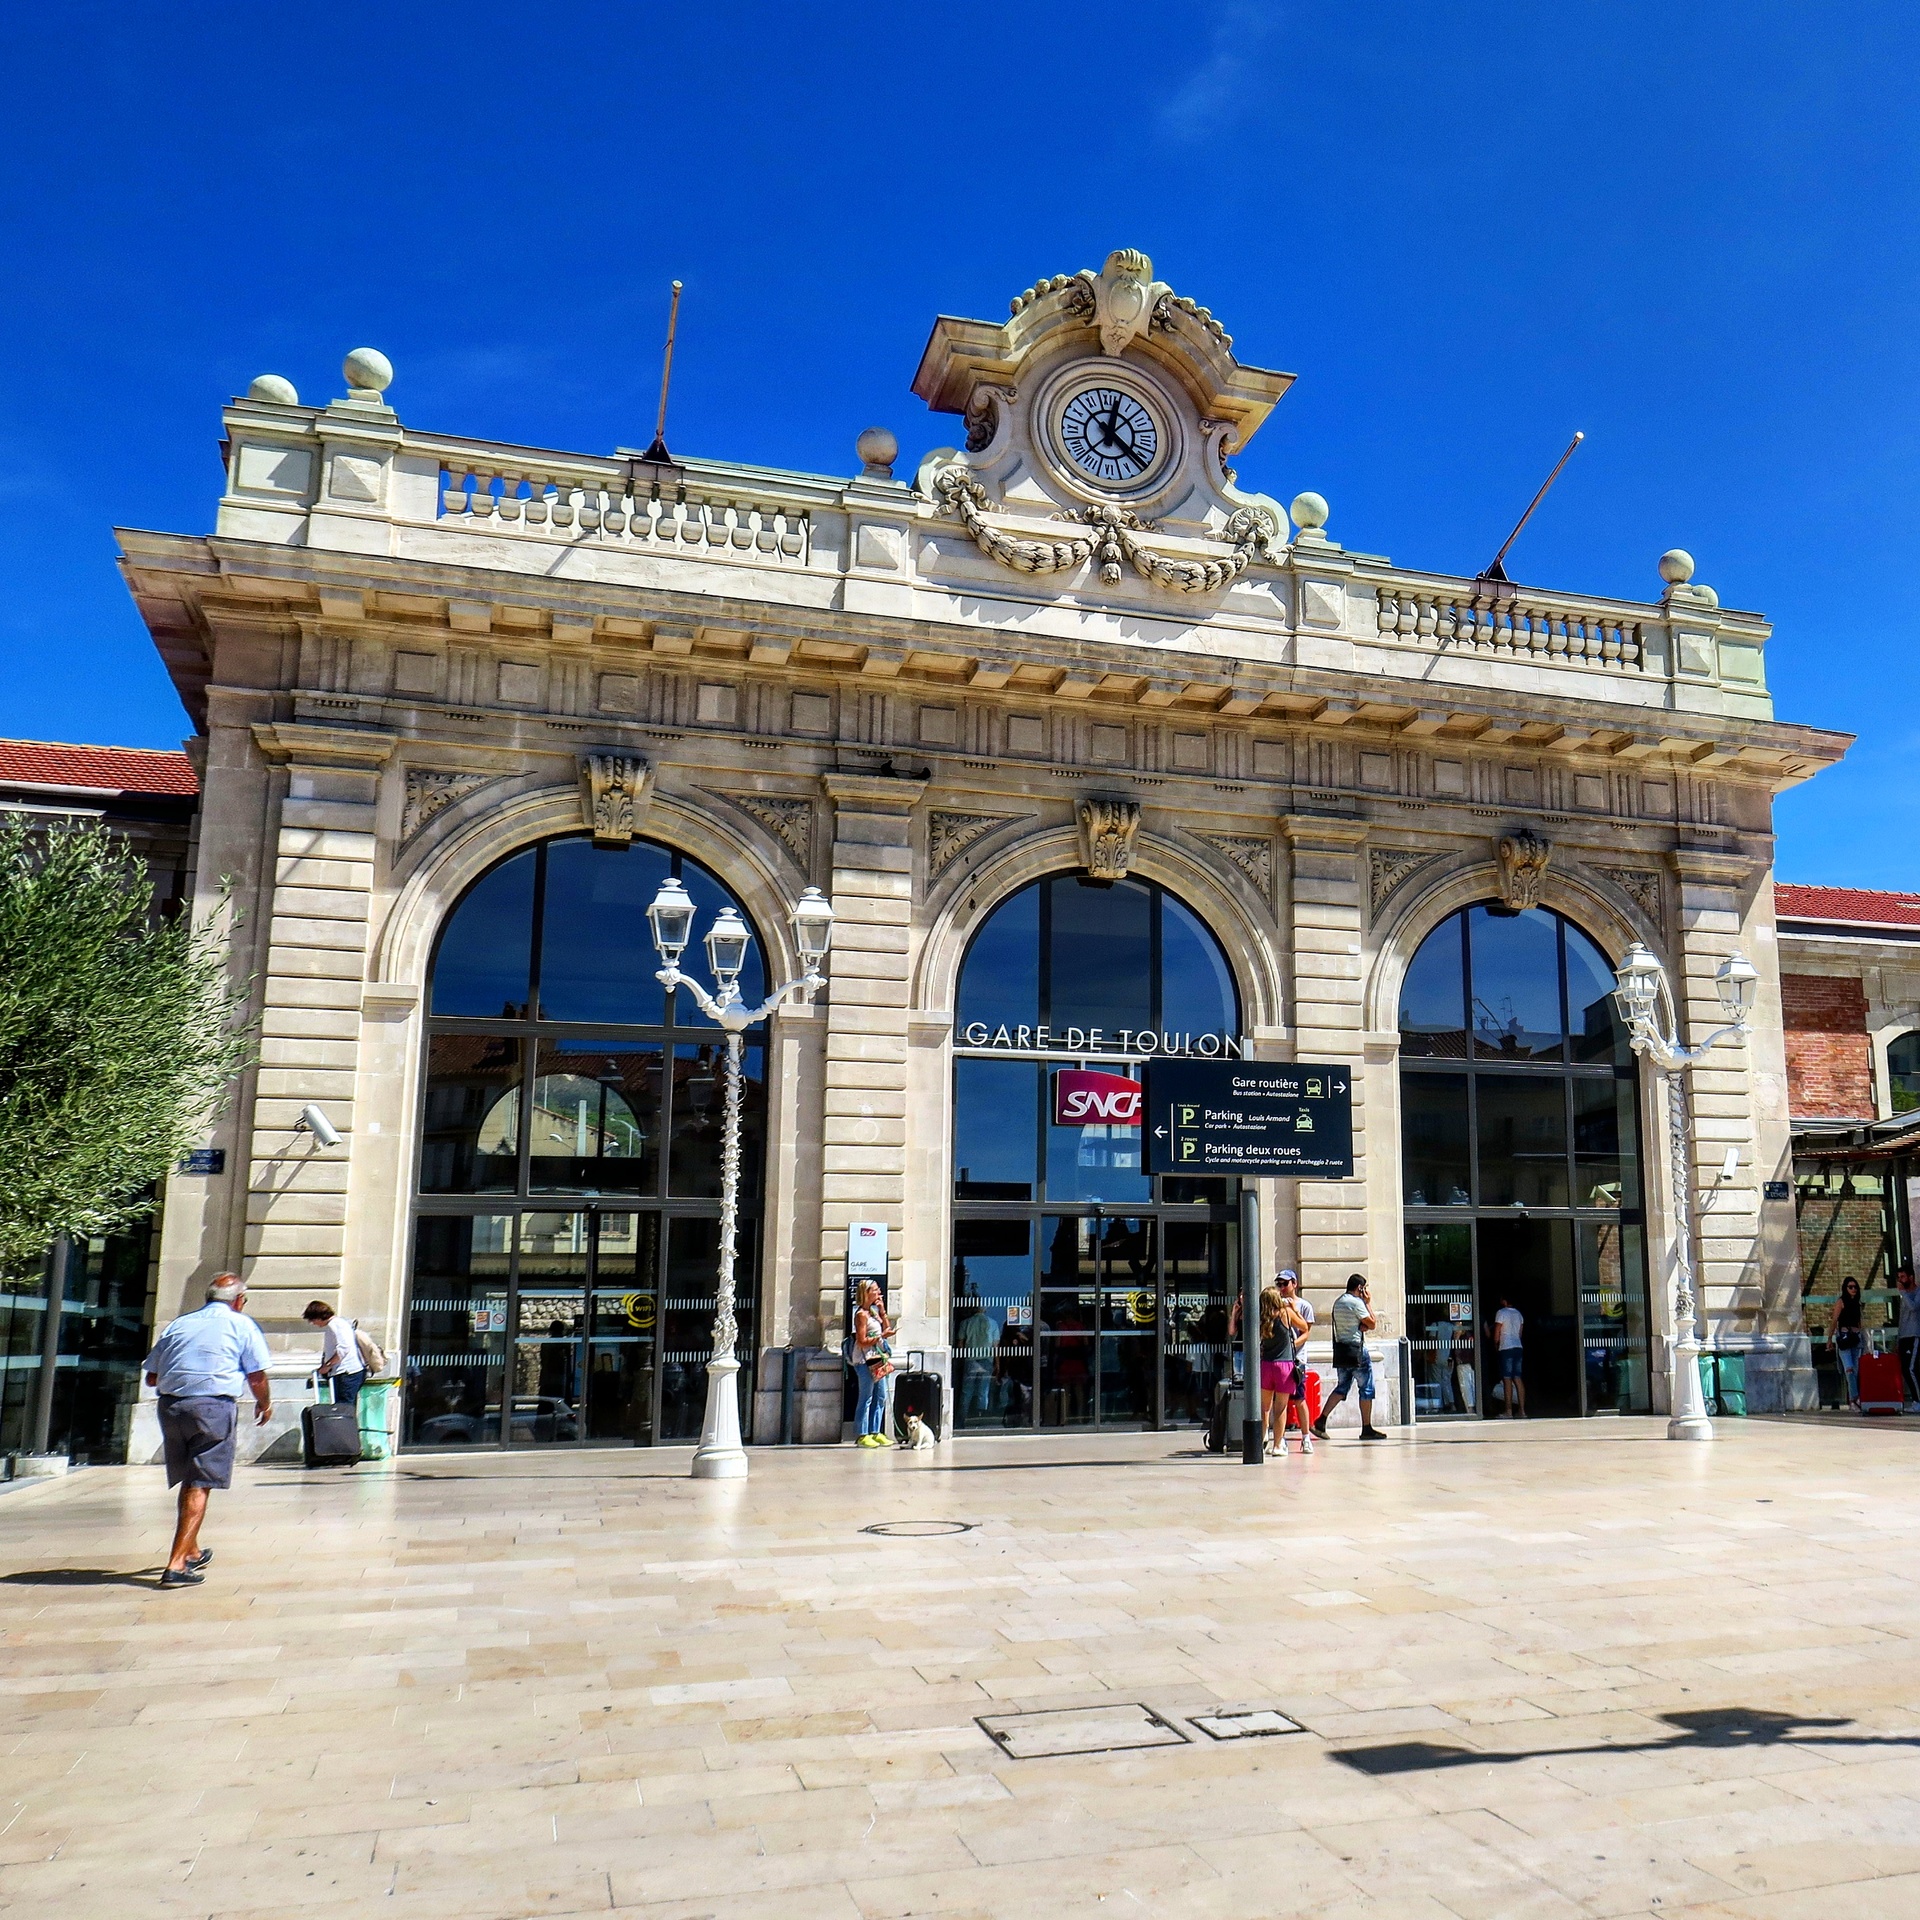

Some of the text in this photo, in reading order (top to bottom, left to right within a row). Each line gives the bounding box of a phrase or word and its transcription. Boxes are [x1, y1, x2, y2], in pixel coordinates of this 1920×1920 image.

[1085, 395, 1097, 408] XI
[1124, 403, 1132, 413] I
[1072, 407, 1084, 418] X
[1135, 417, 1147, 427] II
[1067, 424, 1079, 434] IX
[1140, 435, 1151, 447] III
[966, 1022, 1243, 1056] GARE DE TOULON
[1232, 1076, 1299, 1089] Gare routière
[1062, 1091, 1141, 1117] SNCF
[1182, 1108, 1195, 1125] P
[1205, 1109, 1243, 1123] Parking
[1248, 1114, 1265, 1122] Louis
[1182, 1142, 1196, 1159] P
[1205, 1143, 1301, 1157] Parking deux roues
